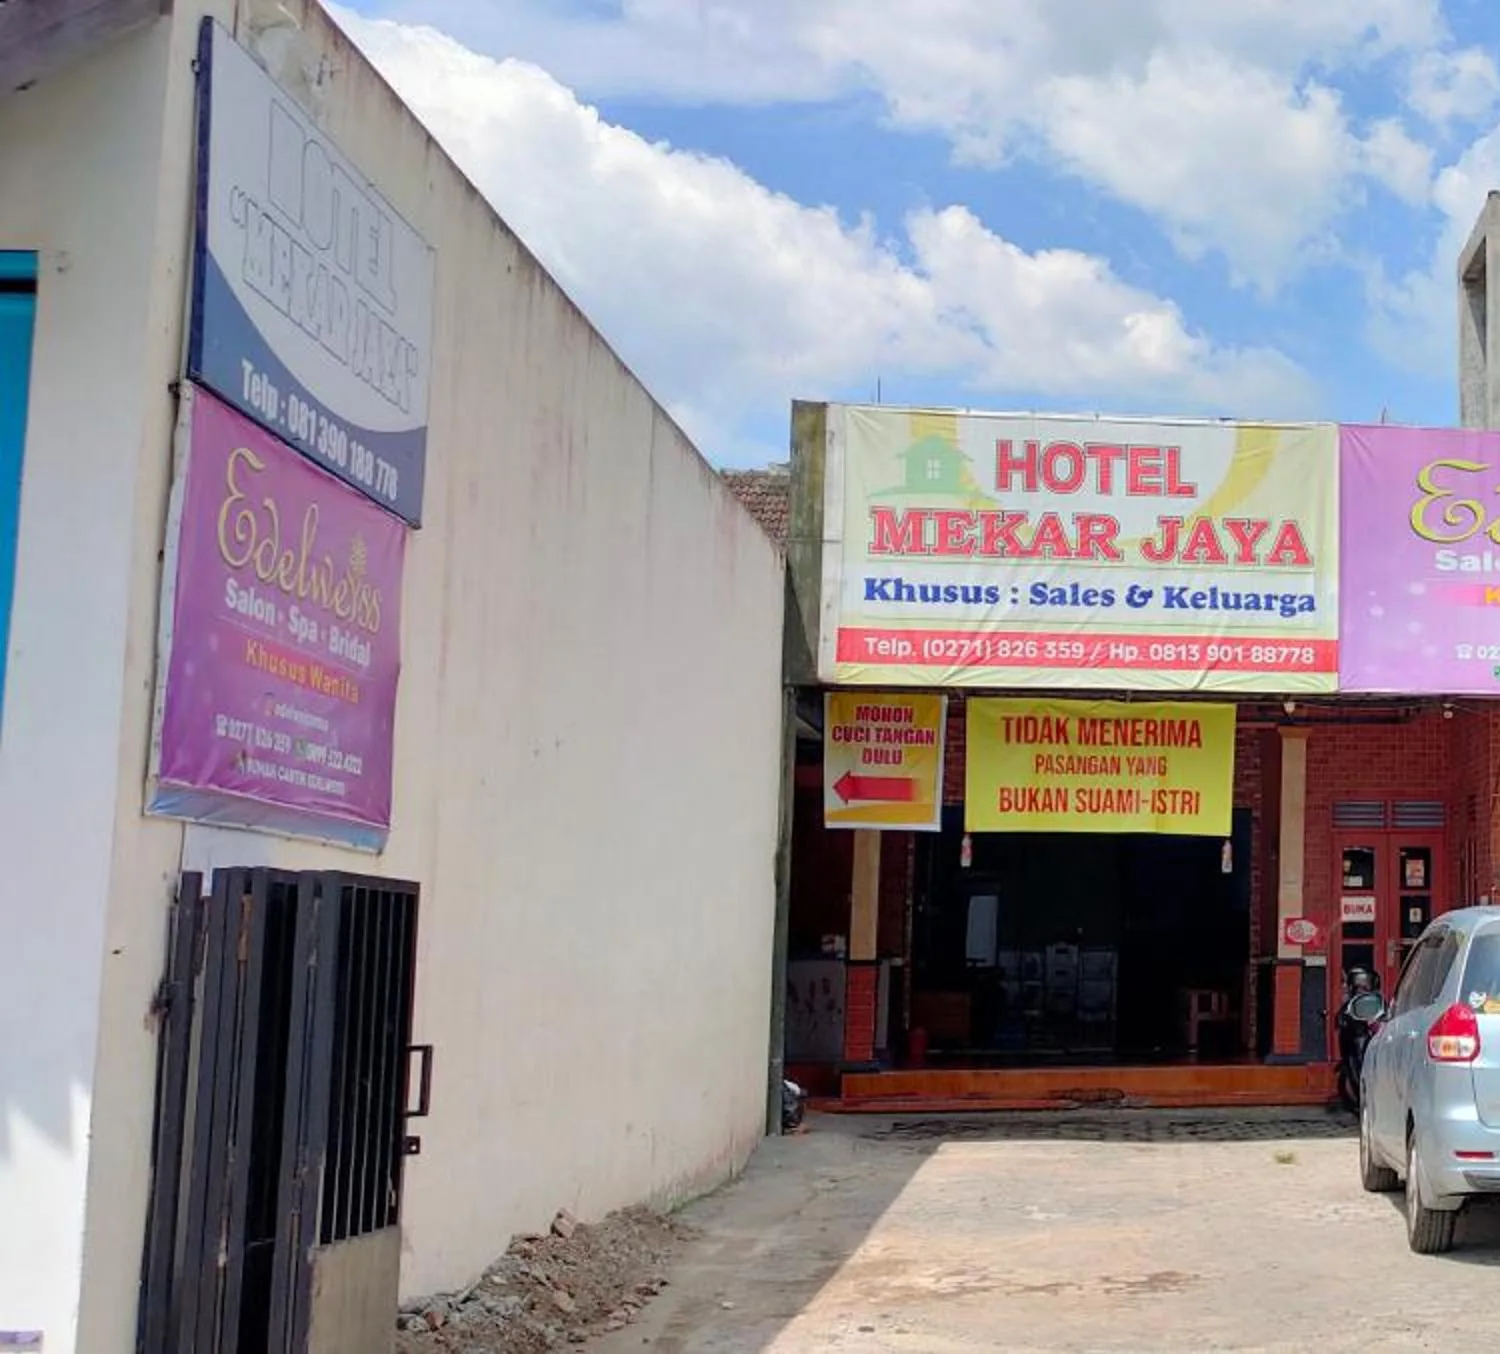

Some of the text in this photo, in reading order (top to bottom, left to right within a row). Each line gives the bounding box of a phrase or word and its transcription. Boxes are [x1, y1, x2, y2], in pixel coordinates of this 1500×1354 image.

[288, 394, 317, 446] 081
[318, 417, 347, 467] 390
[349, 441, 374, 486] 188
[995, 438, 1197, 498] HOTEL
[867, 506, 1314, 568] MEKAR JAYA
[863, 577, 1000, 606] Khusus
[1028, 581, 1115, 608] Sales
[1124, 584, 1154, 610] &
[1163, 586, 1317, 614] Keluarga
[225, 577, 370, 667] Salon Spa Bridal
[864, 637, 917, 660] Telp.
[923, 638, 993, 661] (0271)
[998, 640, 1038, 660] 826
[1043, 641, 1086, 661] 359
[1109, 643, 1146, 666] Hp.
[1150, 643, 1200, 663] 0813
[1206, 644, 1244, 664] 901
[1250, 645, 1315, 665] 88778
[245, 639, 359, 704] Khusus Wanita
[855, 704, 914, 724] MOHON
[832, 725, 935, 746] CUCI TANGAN
[1002, 716, 1202, 749] TIDAK MENERIMA
[862, 748, 903, 766] DULU
[1034, 754, 1168, 777] PASANGAN YANG
[999, 788, 1201, 815] BUKAN SUAMI-ISTRI
[1343, 903, 1373, 914] BUKA
